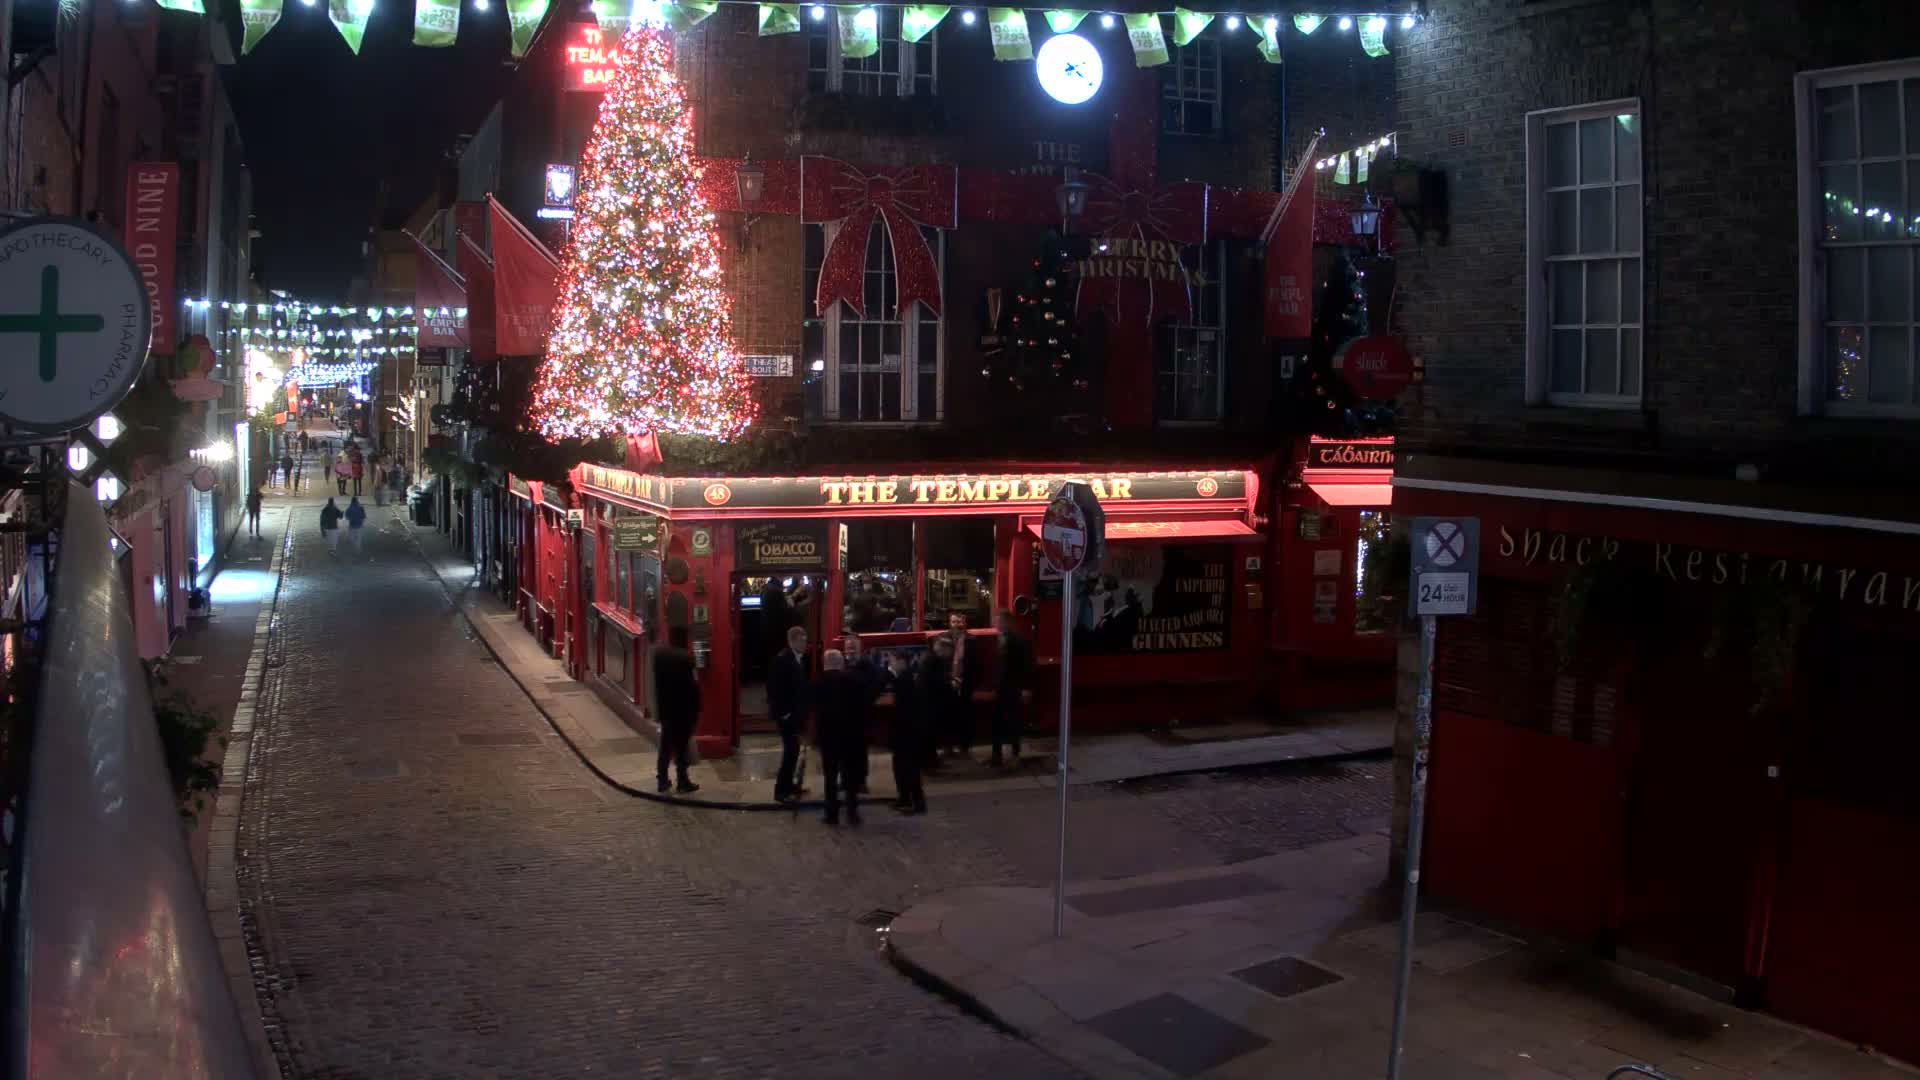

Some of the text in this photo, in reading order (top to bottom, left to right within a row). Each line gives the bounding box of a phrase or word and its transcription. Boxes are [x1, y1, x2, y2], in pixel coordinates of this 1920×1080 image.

[136, 171, 168, 233] NINE
[823, 481, 898, 504] THE
[910, 479, 1049, 502] TEMPLE
[750, 538, 816, 561] TOBACCO
[1421, 583, 1442, 603] 24
[1132, 631, 1224, 649] GUINNESS
